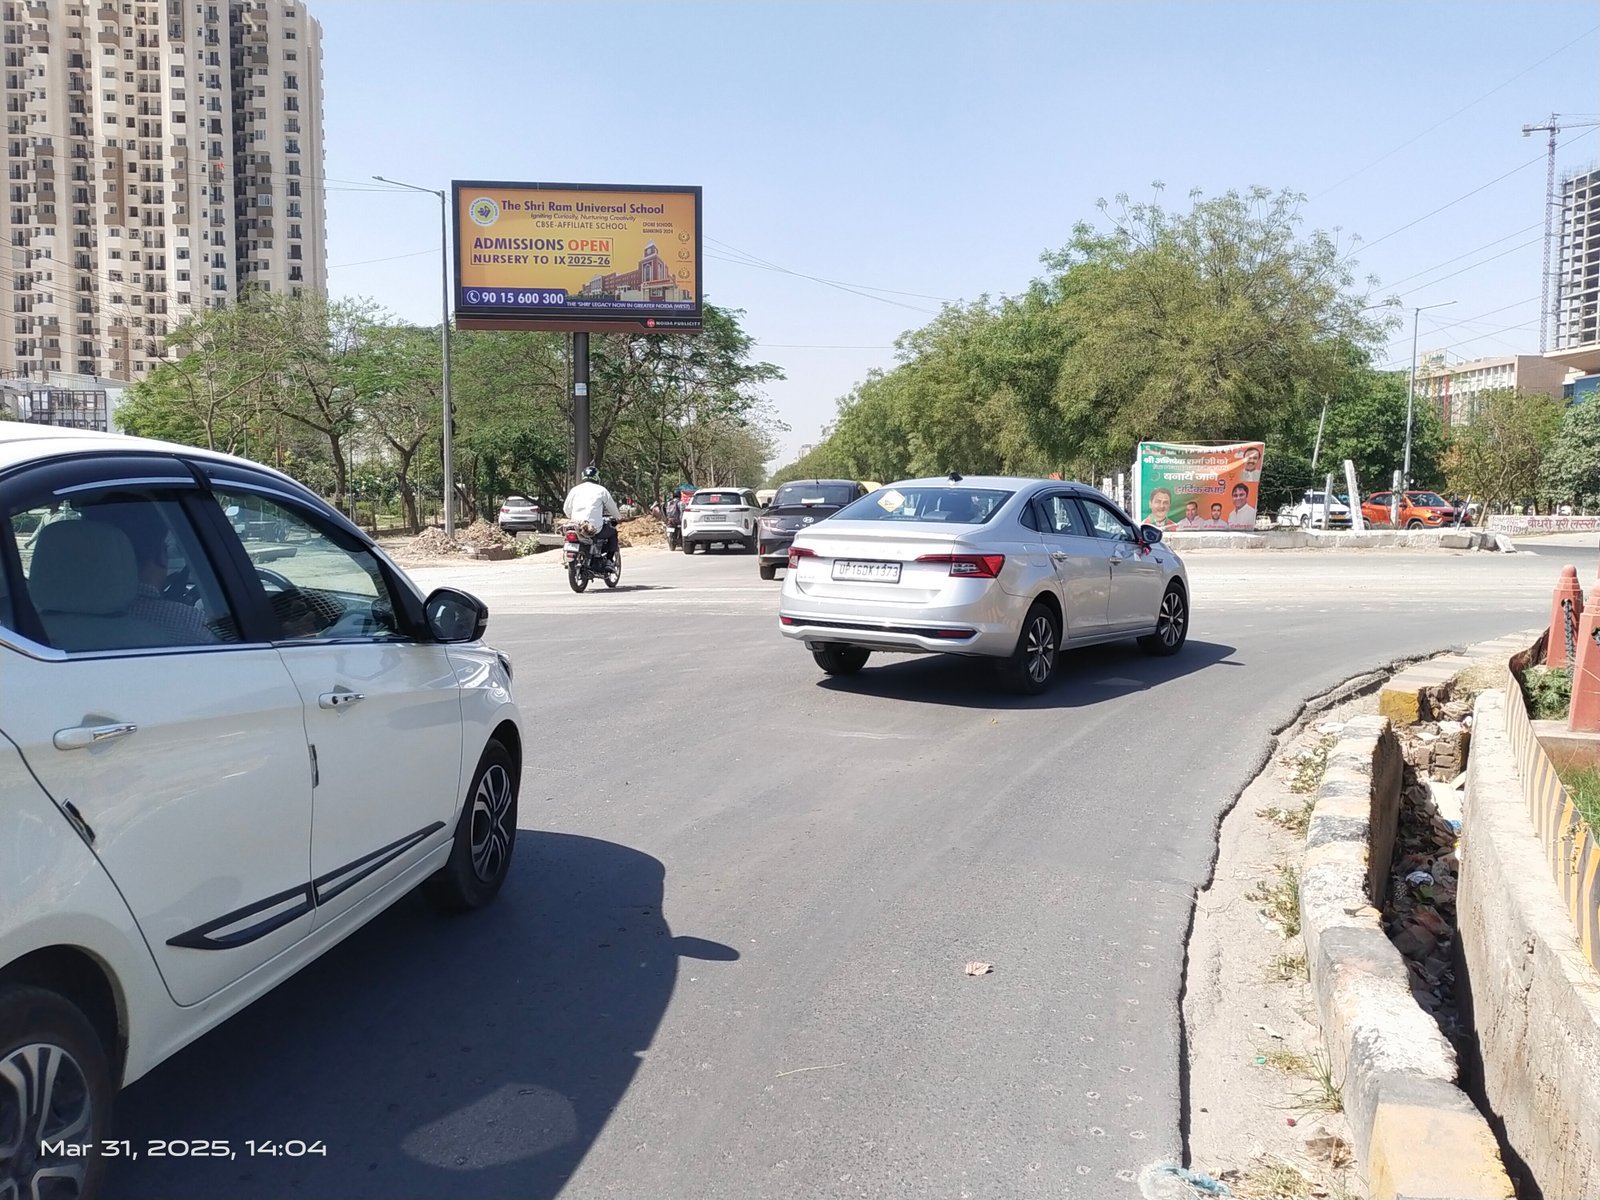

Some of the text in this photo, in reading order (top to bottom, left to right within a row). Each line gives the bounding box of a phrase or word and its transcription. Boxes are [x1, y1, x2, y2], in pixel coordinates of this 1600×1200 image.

[501, 200, 664, 214] The Shri Ram Universal School
[530, 213, 553, 221] Igniting
[580, 214, 608, 222] Nurturing
[609, 215, 636, 223] Creativity
[535, 221, 628, 231] CBSE-AFFILIATE SCHOOL
[473, 238, 610, 252] ADMISSIONS OPEN
[473, 254, 611, 265] NURSERY TO IX 2025-26
[482, 292, 564, 304] 90 15 600 300
[1143, 456, 1154, 464] श्री
[1527, 517, 1553, 530] चौधरी
